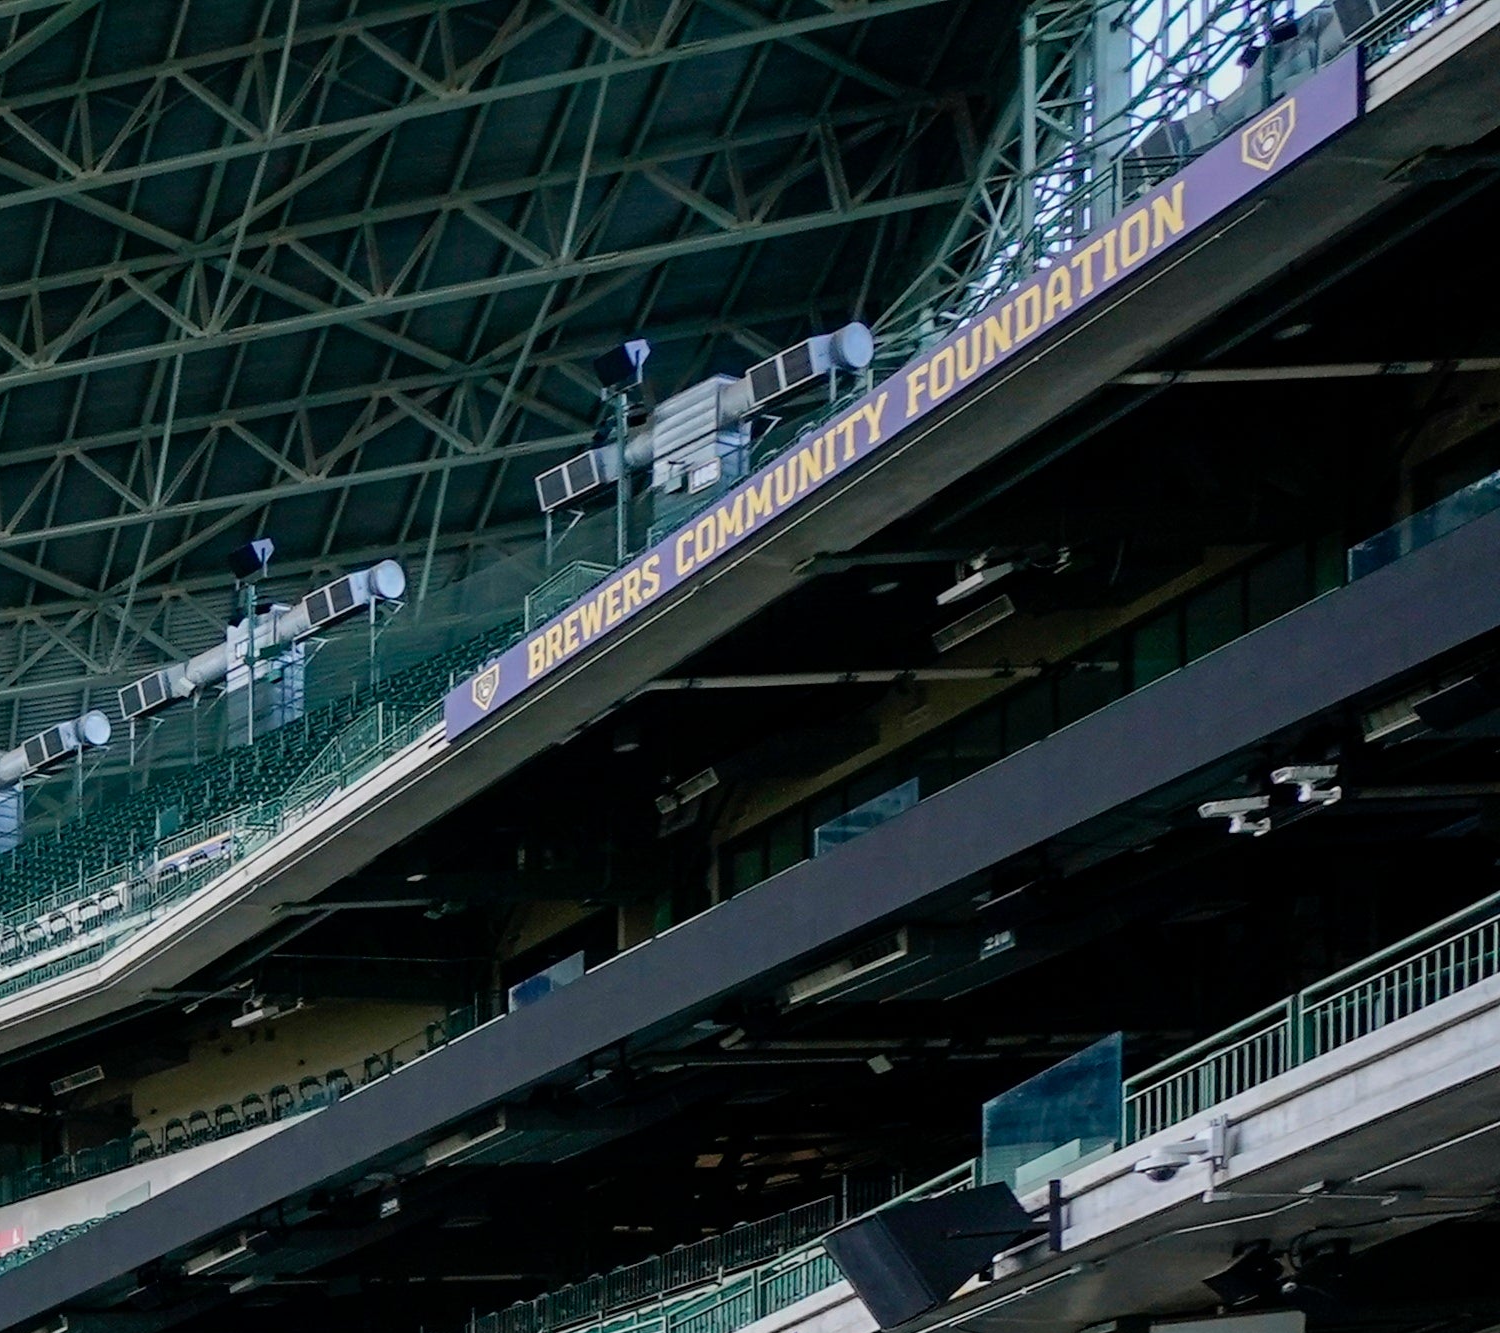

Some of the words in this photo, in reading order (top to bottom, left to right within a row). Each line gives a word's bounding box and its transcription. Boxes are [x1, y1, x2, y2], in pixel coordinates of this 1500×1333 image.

[526, 550, 662, 679] BREWERS
[673, 392, 890, 578] COMMUNITY
[904, 182, 1186, 418] FOUNDATION
